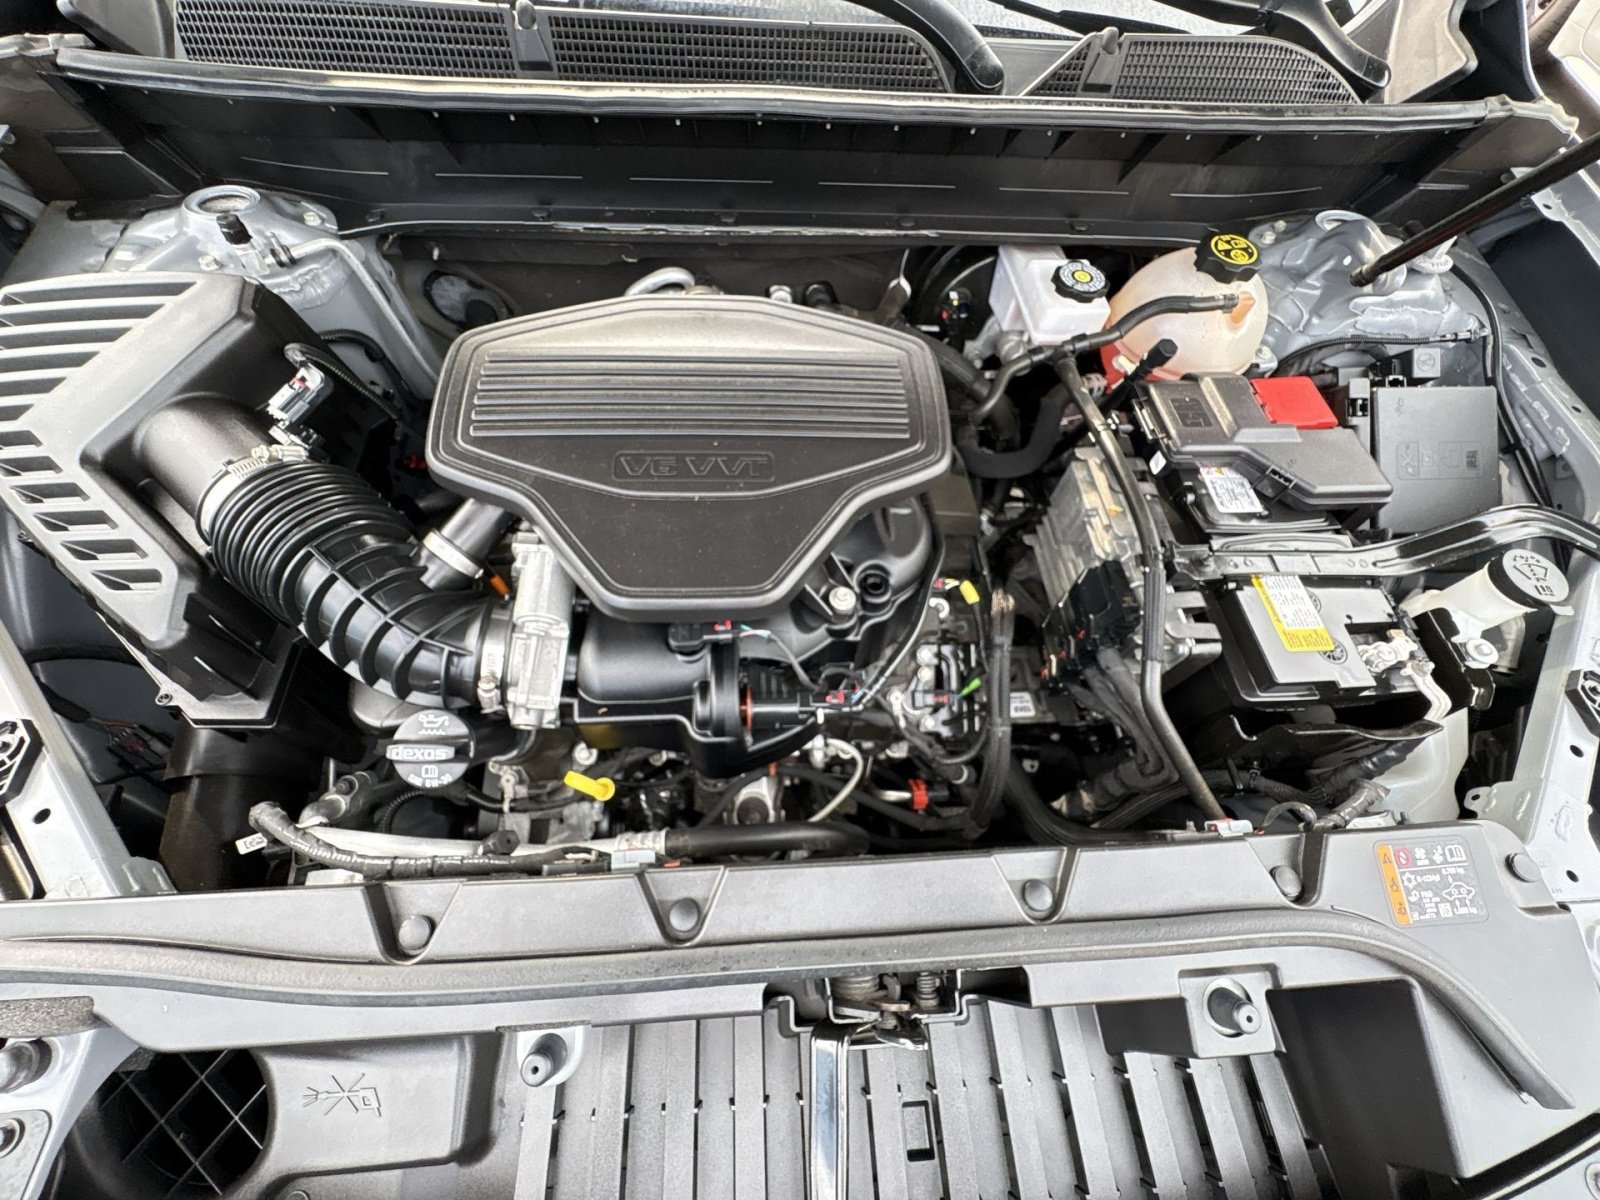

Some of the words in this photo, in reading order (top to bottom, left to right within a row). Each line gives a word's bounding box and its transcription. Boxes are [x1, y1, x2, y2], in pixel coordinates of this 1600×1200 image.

[619, 456, 678, 477] V6
[685, 456, 768, 477] VVT
[391, 745, 449, 760] dexos
